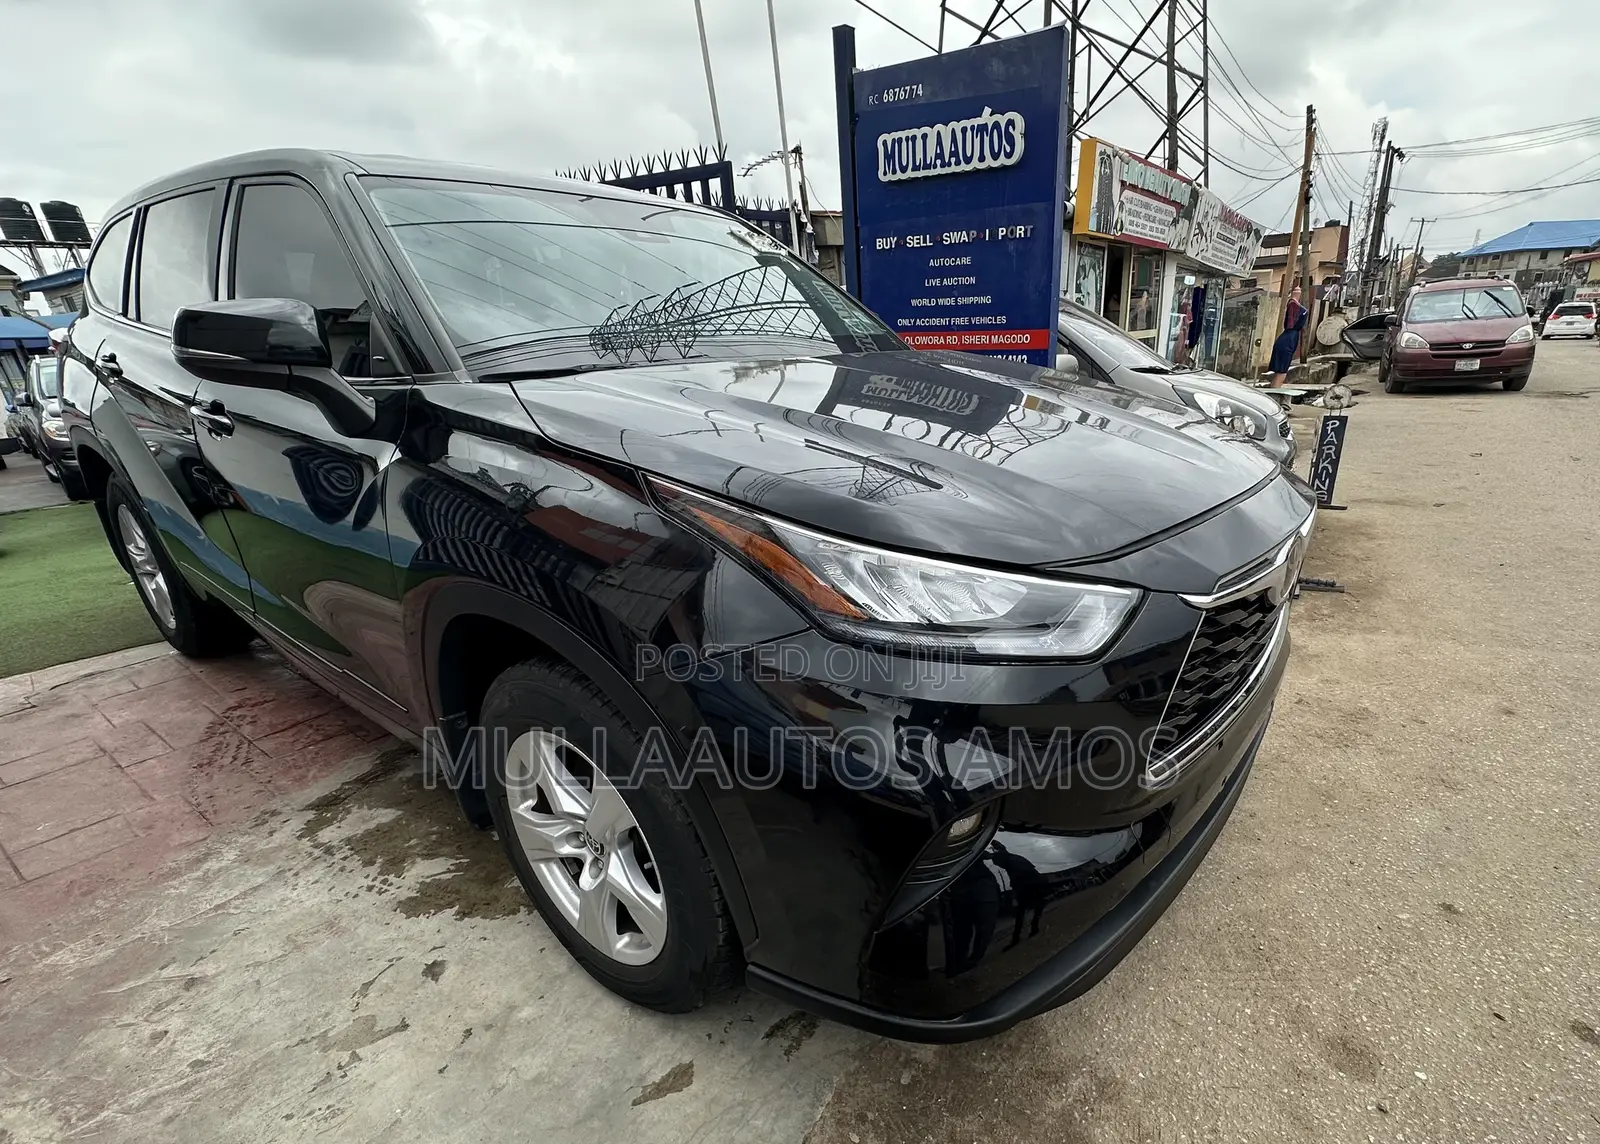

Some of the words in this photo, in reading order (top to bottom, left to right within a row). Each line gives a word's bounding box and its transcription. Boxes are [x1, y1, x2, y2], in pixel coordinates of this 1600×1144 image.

[868, 94, 879, 105] RC
[883, 83, 923, 103] 6876774
[879, 116, 1018, 178] MULLAAUTOS
[876, 236, 898, 250] BUY
[906, 234, 934, 248] SELL
[942, 230, 977, 245] SWAP
[929, 256, 972, 267] AUTOCARE
[925, 278, 941, 287] LIVE
[942, 276, 976, 286] AUCTION
[910, 298, 936, 307] WORLD
[937, 297, 956, 306] WIDE
[957, 295, 992, 305] SHIPPING
[897, 318, 915, 326] ONLY
[915, 317, 950, 326] ACCIDENT
[951, 316, 969, 325] FREE
[970, 315, 1007, 325] VEHICLES
[904, 335, 945, 345] OLOWORA
[946, 335, 960, 346] RD,
[961, 334, 989, 345] ISHERI
[991, 333, 1031, 344] MAGODO
[1313, 420, 1340, 501] PARKING
